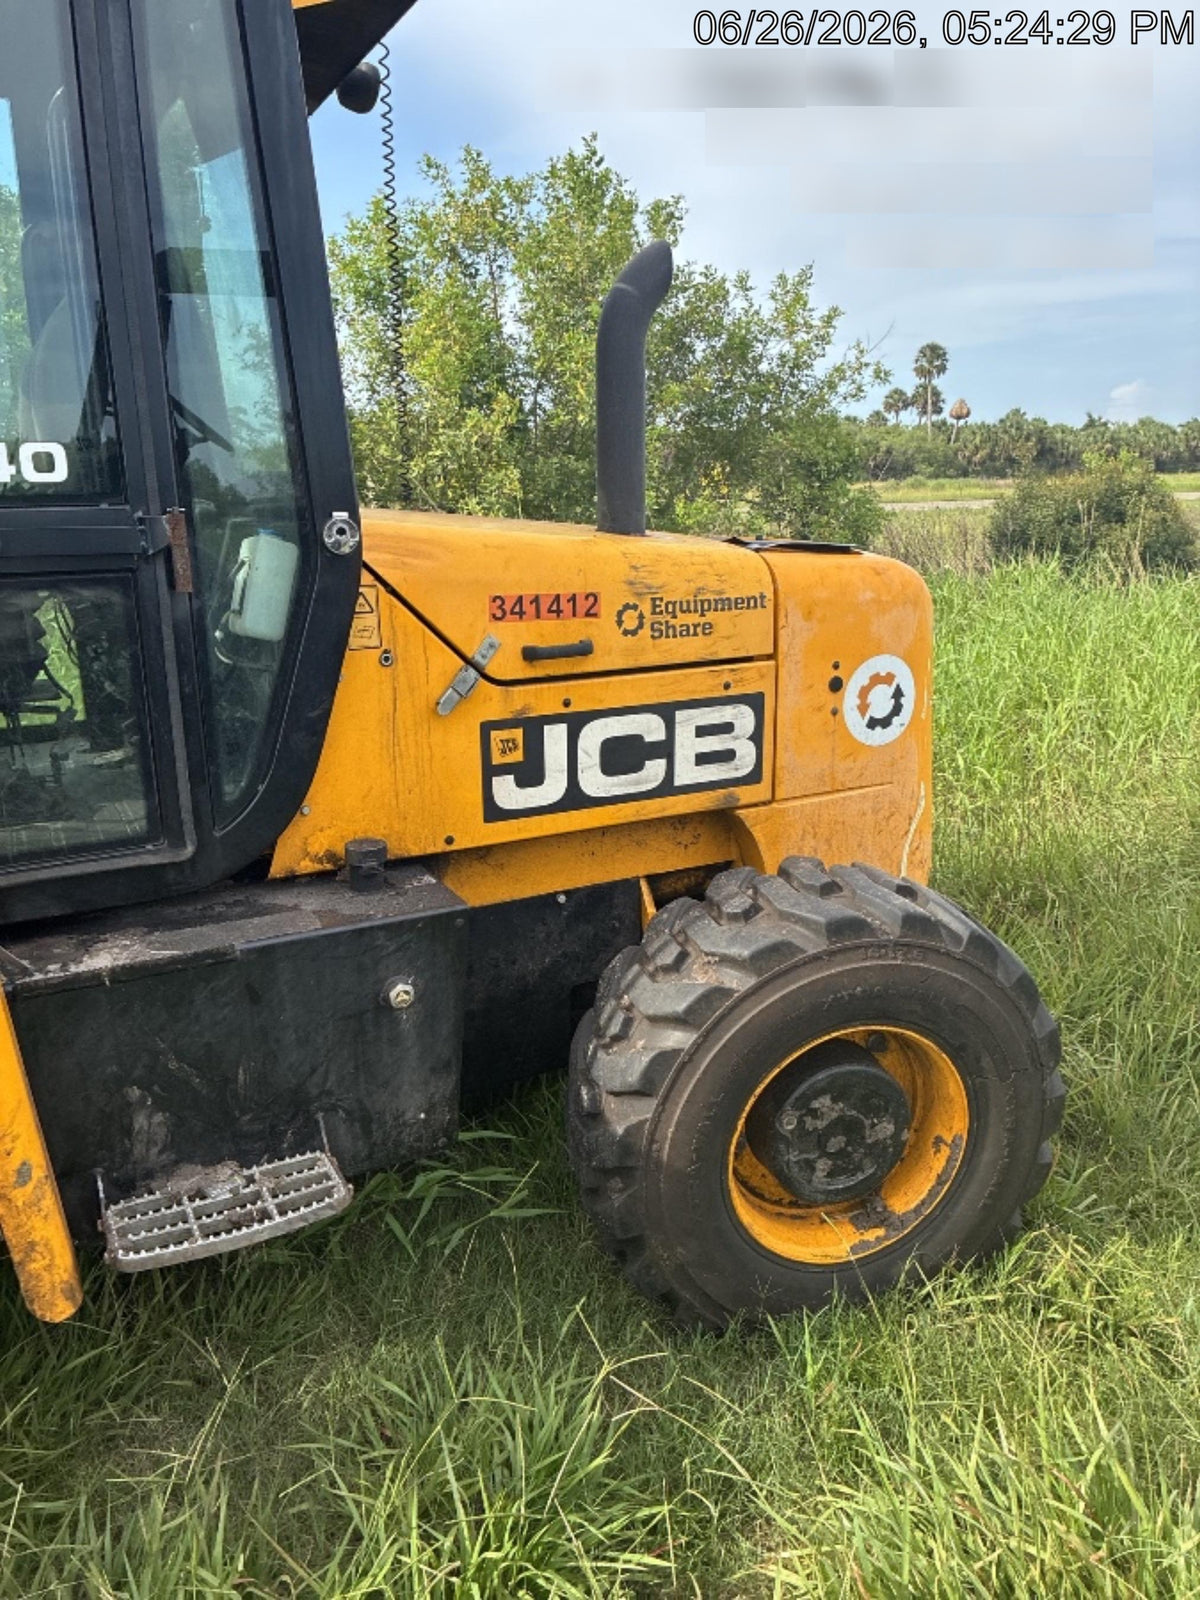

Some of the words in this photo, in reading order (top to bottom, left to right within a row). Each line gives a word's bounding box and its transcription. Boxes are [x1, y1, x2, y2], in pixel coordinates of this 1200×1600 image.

[491, 592, 599, 621] 341412
[650, 592, 767, 618] Equipment
[650, 620, 714, 640] Share
[492, 703, 757, 810] JCB
